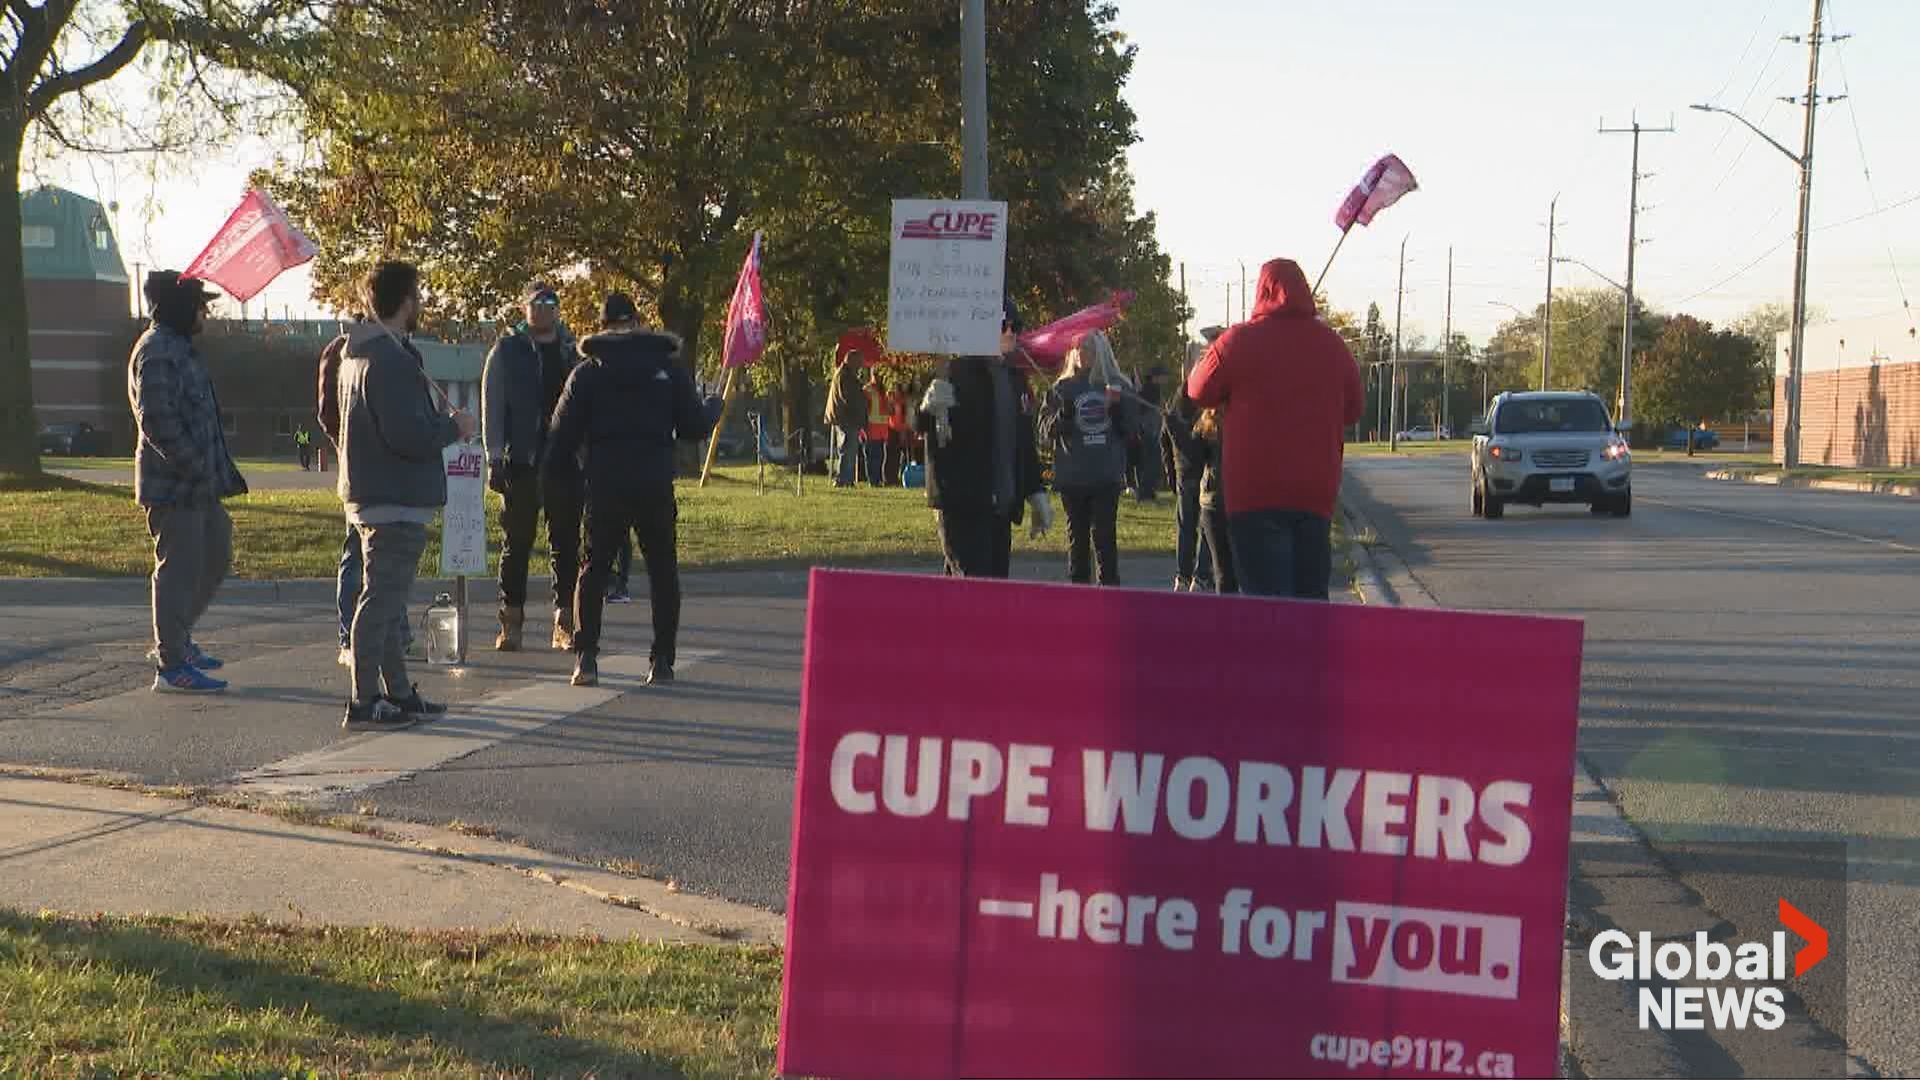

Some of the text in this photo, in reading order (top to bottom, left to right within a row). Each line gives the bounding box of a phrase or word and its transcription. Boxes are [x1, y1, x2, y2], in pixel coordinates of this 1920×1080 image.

[928, 211, 997, 233] CUPE
[830, 731, 1532, 866] CUPE WORKERS
[1219, 889, 1326, 960] for
[1345, 915, 1509, 981] you.
[1311, 1035, 1514, 1079] cupe9112.ca
